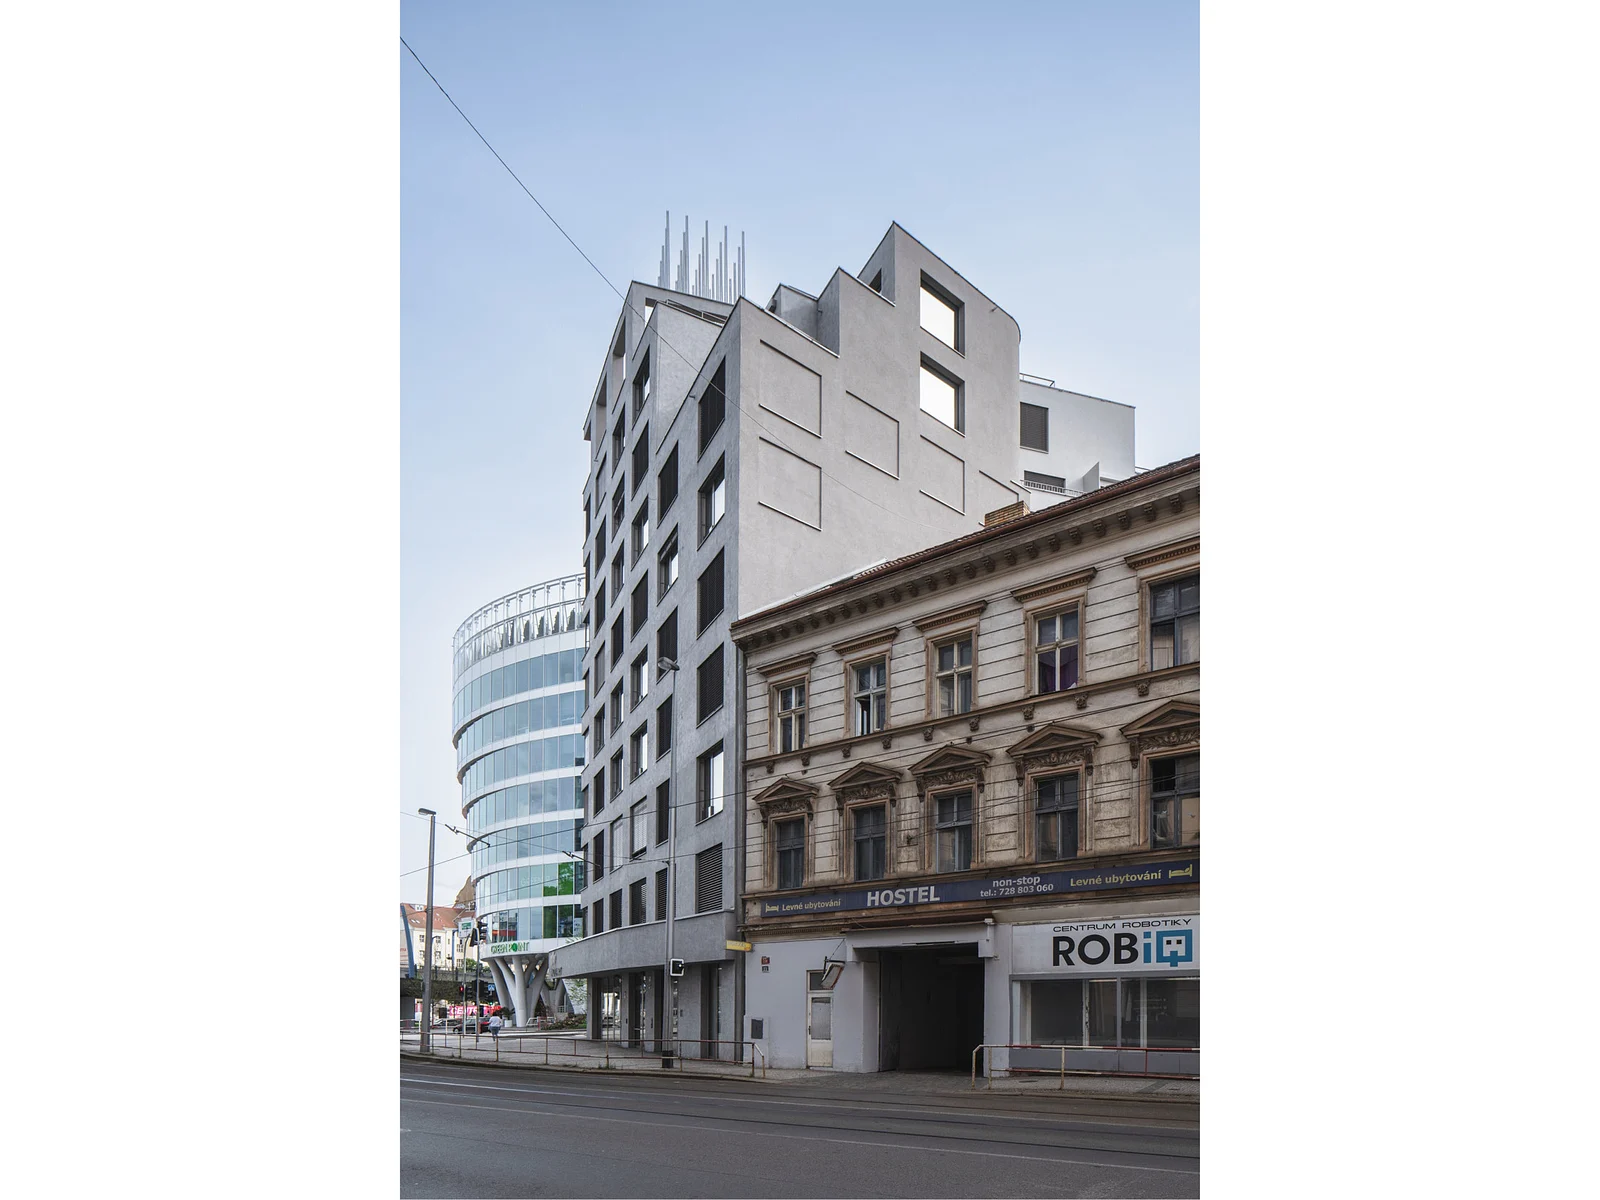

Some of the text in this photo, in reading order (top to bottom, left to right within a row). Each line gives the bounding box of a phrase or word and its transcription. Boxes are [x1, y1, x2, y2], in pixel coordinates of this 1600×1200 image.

[992, 876, 1041, 888] non-stop
[1070, 869, 1162, 887] Levné ubytování
[867, 886, 940, 907] HOSTEL
[980, 883, 1054, 897] tel.: 728 803 060
[782, 899, 841, 911] Levné ubytování
[1053, 919, 1192, 932] CENTRUM ROBOTIKY
